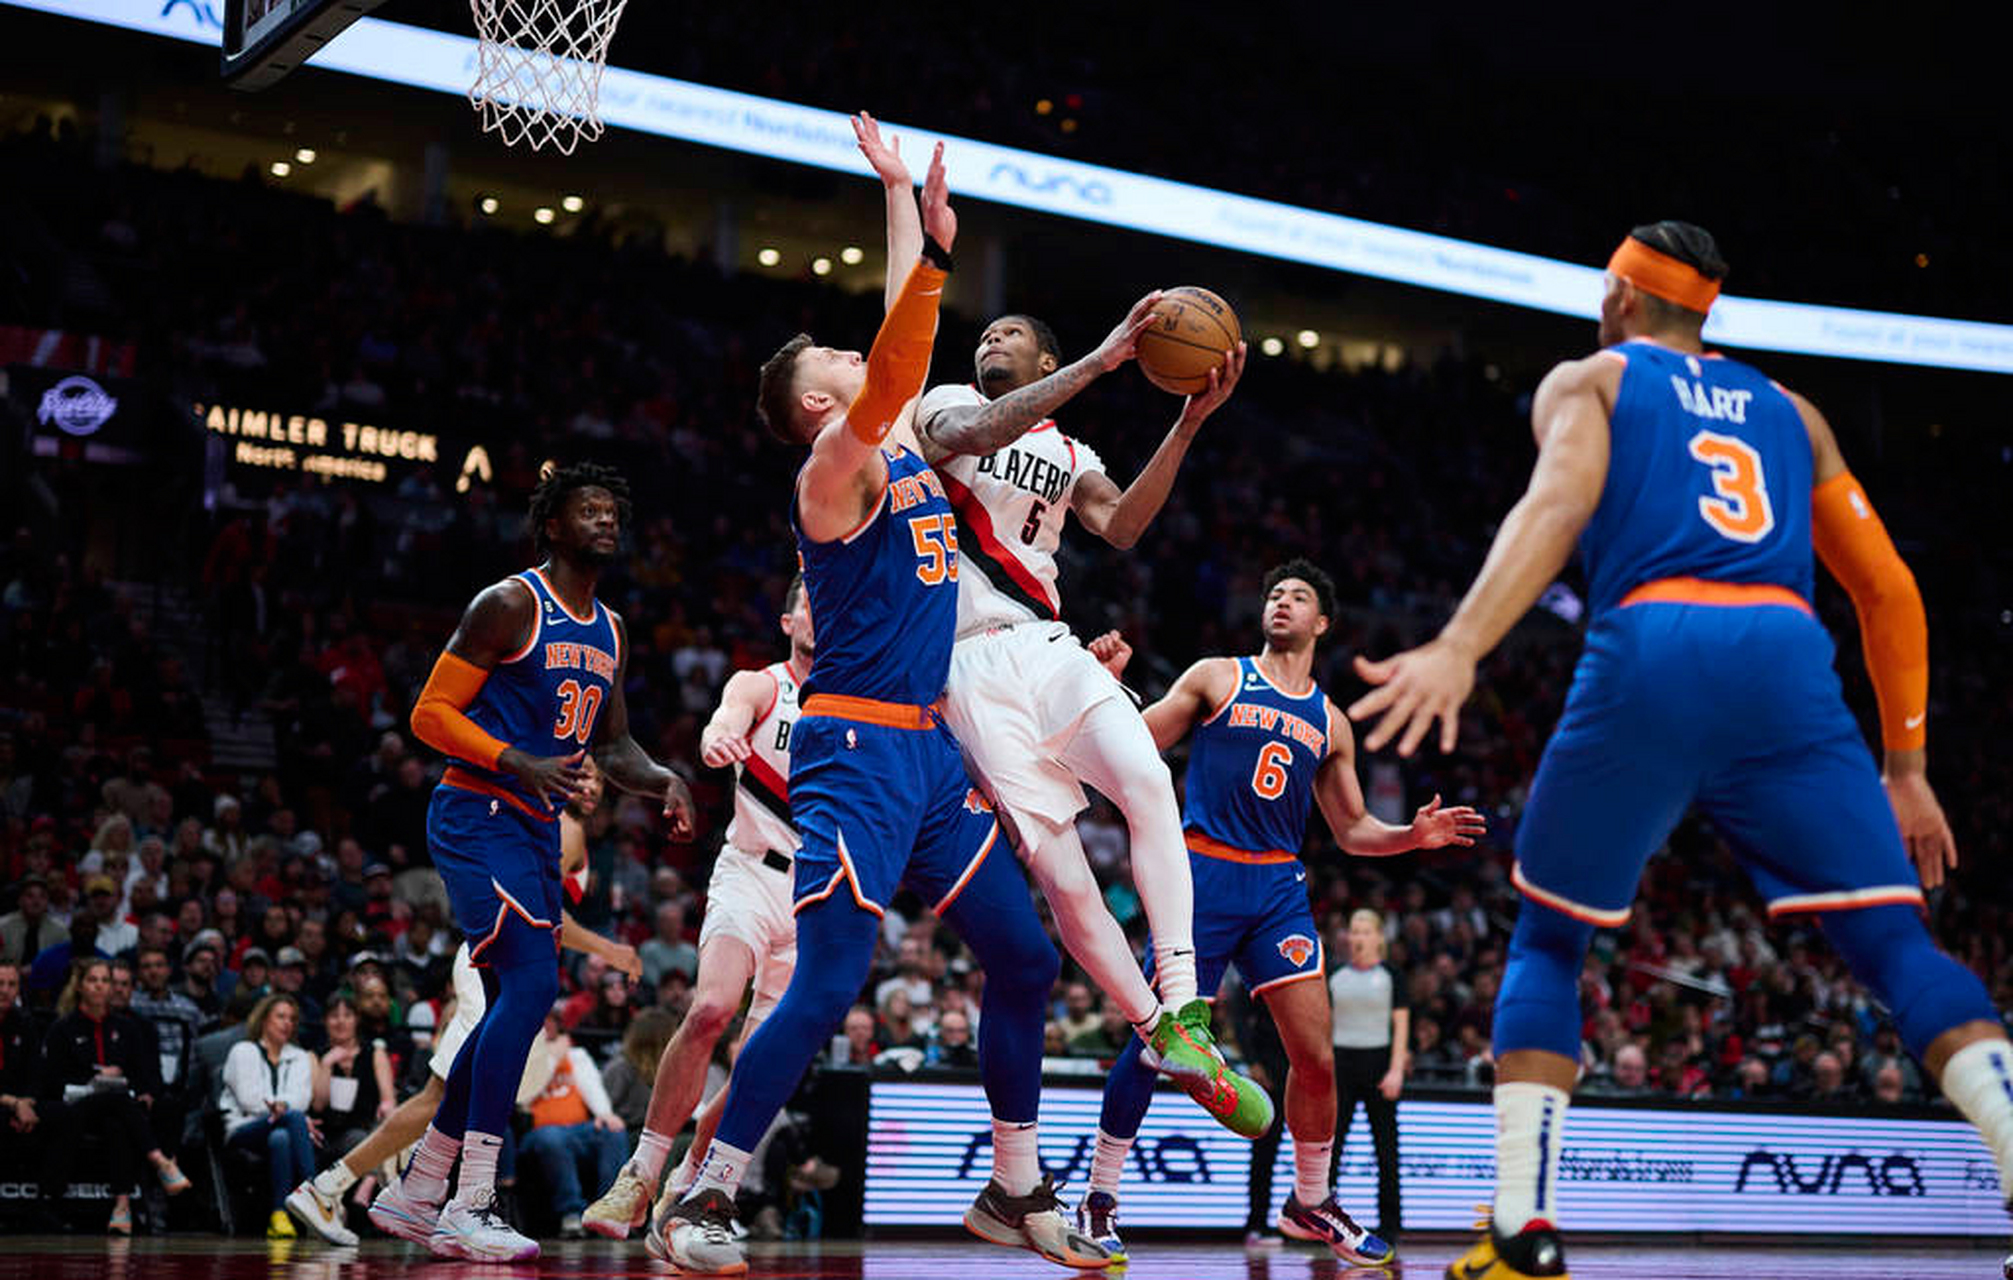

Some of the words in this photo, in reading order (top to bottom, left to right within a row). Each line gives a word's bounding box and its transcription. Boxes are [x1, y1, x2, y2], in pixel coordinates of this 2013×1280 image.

[989, 162, 1113, 206] nuna
[1670, 374, 1753, 424] HART
[194, 403, 327, 447] AIMLER
[342, 422, 439, 462] TRUCK
[889, 475, 928, 514] NEW
[977, 447, 1071, 506] BLAZERS
[1687, 429, 1776, 544] 3
[907, 512, 959, 587] 55
[1020, 499, 1046, 546] 5
[545, 641, 581, 669] NEW
[553, 678, 603, 745] 30
[1227, 702, 1280, 731] NEW
[1279, 710, 1326, 759] YORK
[1251, 740, 1294, 801] 6
[1732, 1149, 1928, 1197] nuna
